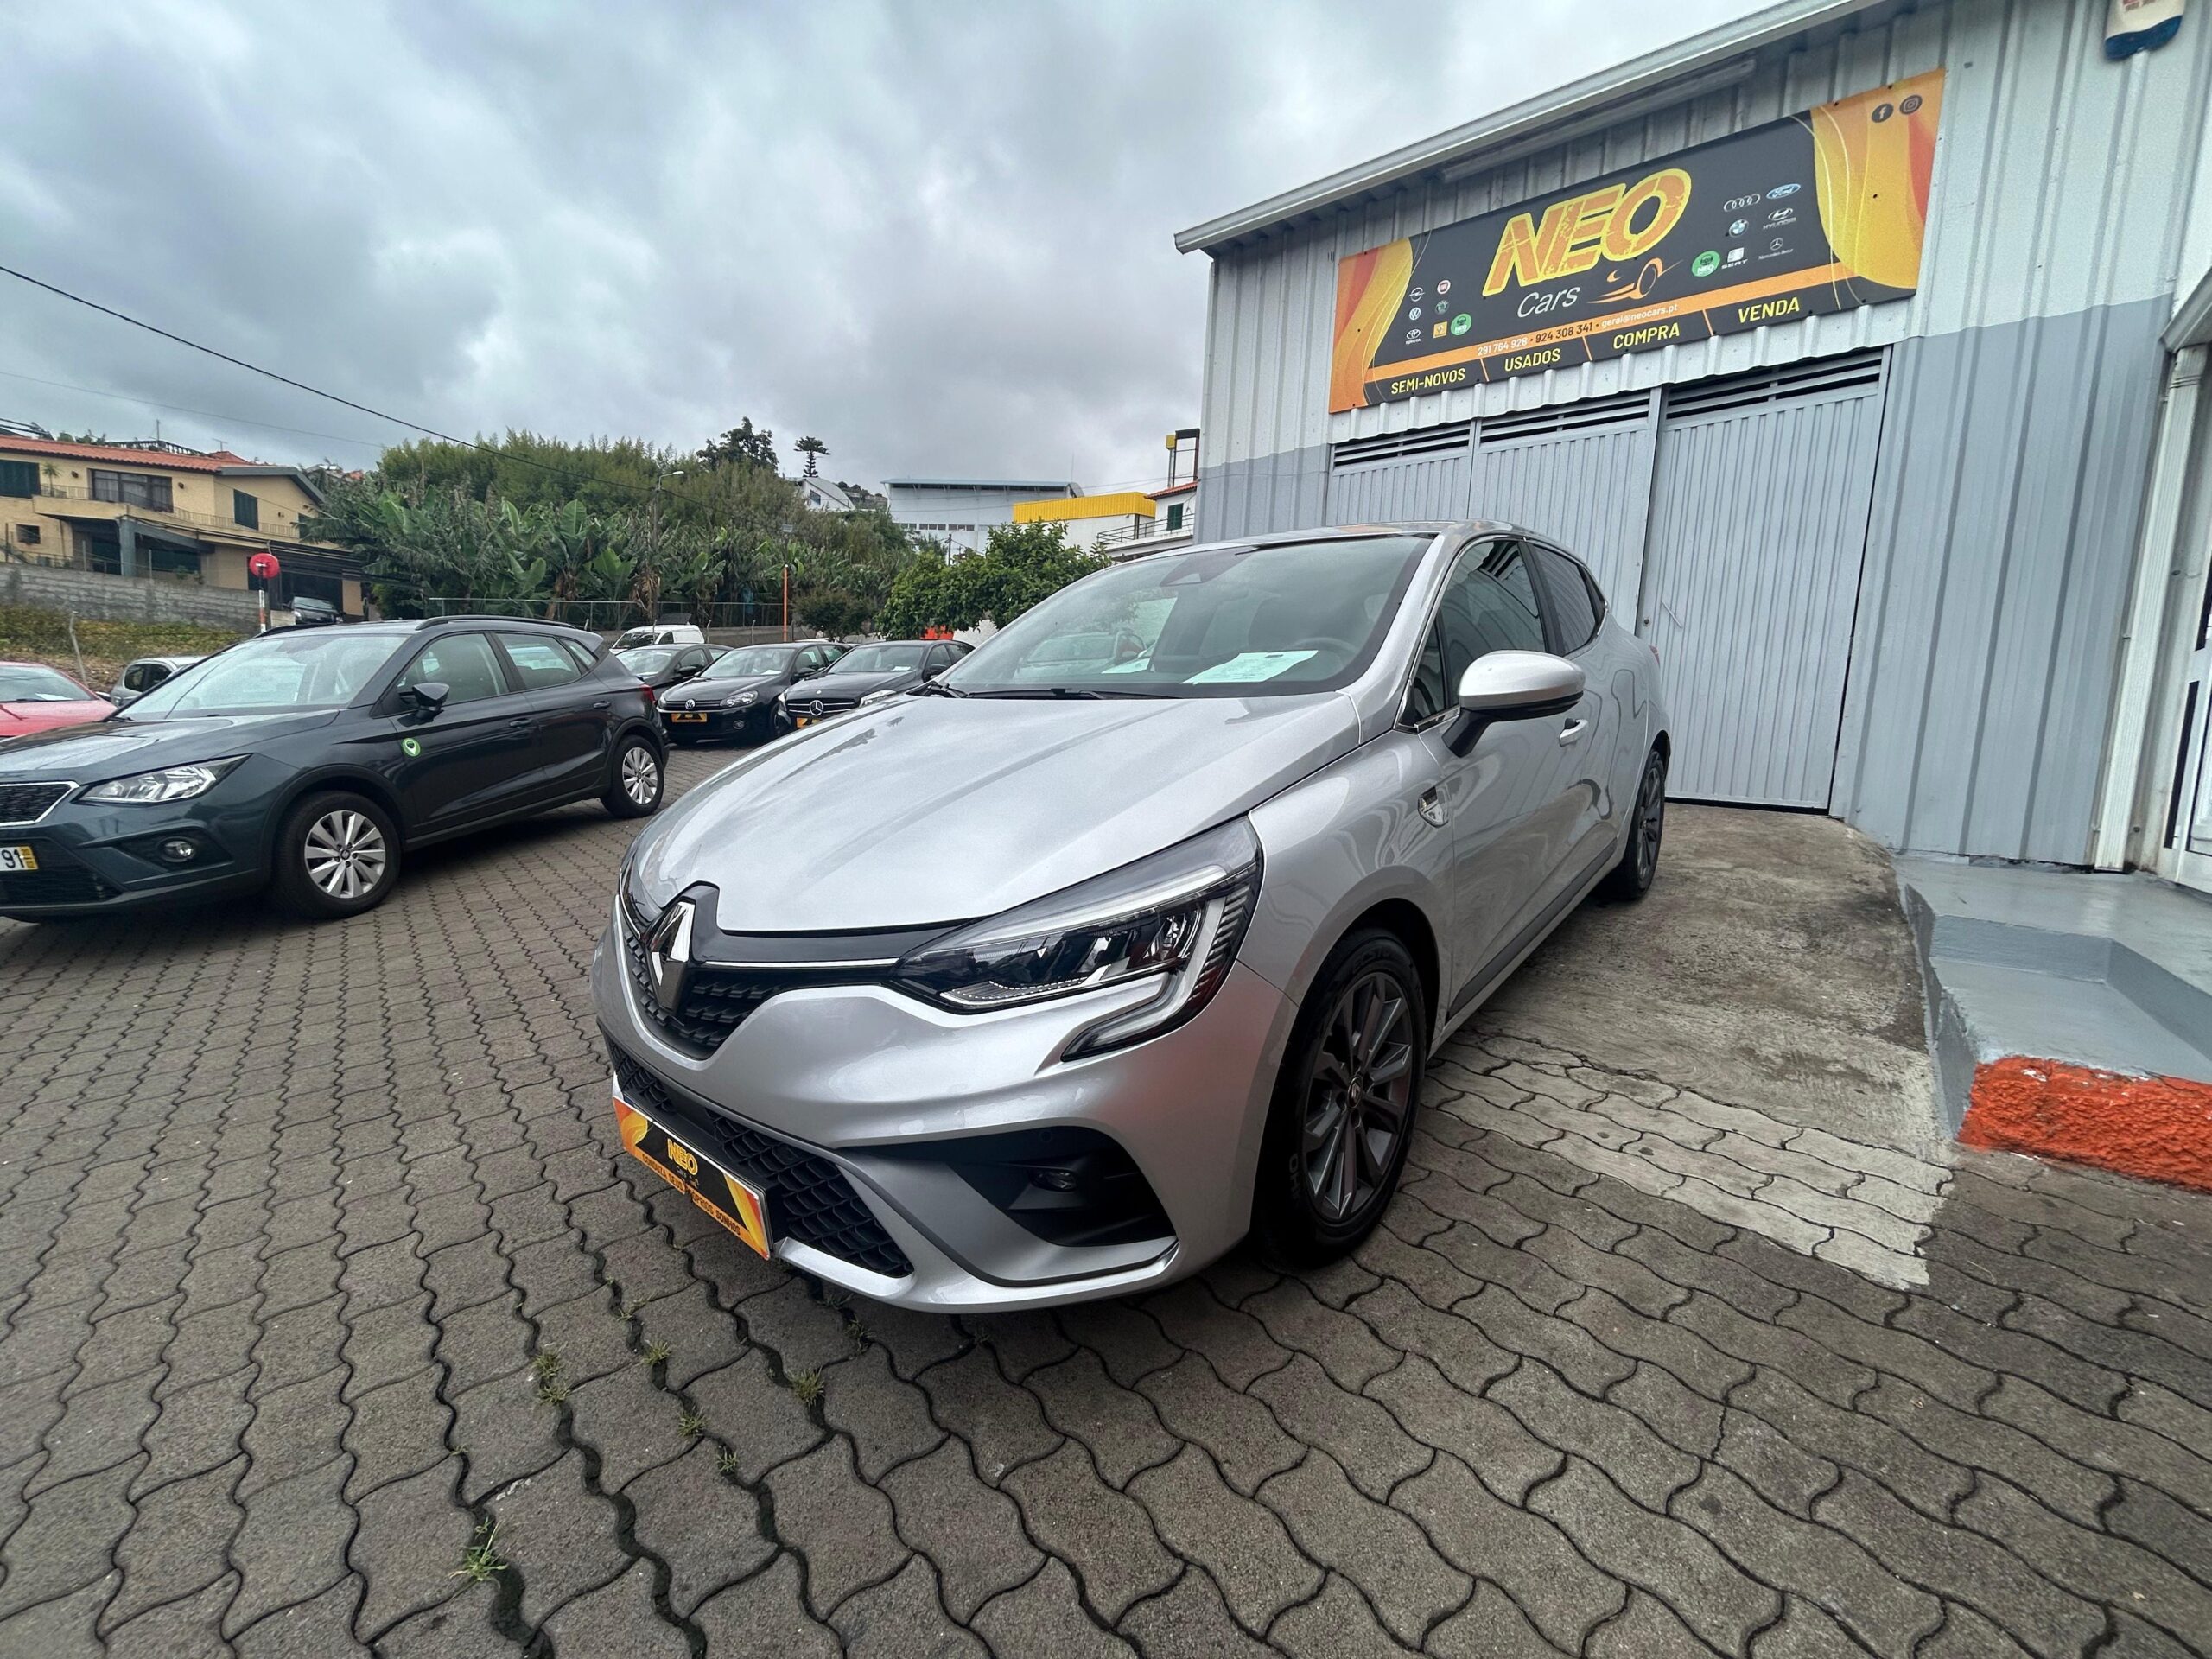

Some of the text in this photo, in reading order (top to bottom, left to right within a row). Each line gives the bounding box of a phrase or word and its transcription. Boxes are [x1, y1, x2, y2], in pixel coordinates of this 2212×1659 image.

[1482, 168, 1692, 296] NEO
[1721, 258, 1748, 270] SEAT
[1516, 286, 1580, 318] Cars
[1738, 296, 1801, 324] VENDA
[1478, 303, 1678, 356] 291 764 928 924 308 341 geral@neocars.pt
[1613, 322, 1680, 350] COMPRA
[1504, 347, 1561, 372] USADOS
[1390, 367, 1465, 395] SEMI-NOVOS
[1, 849, 25, 868] 91
[667, 1138, 698, 1176] NEO
[715, 1210, 741, 1236] SONHOS
